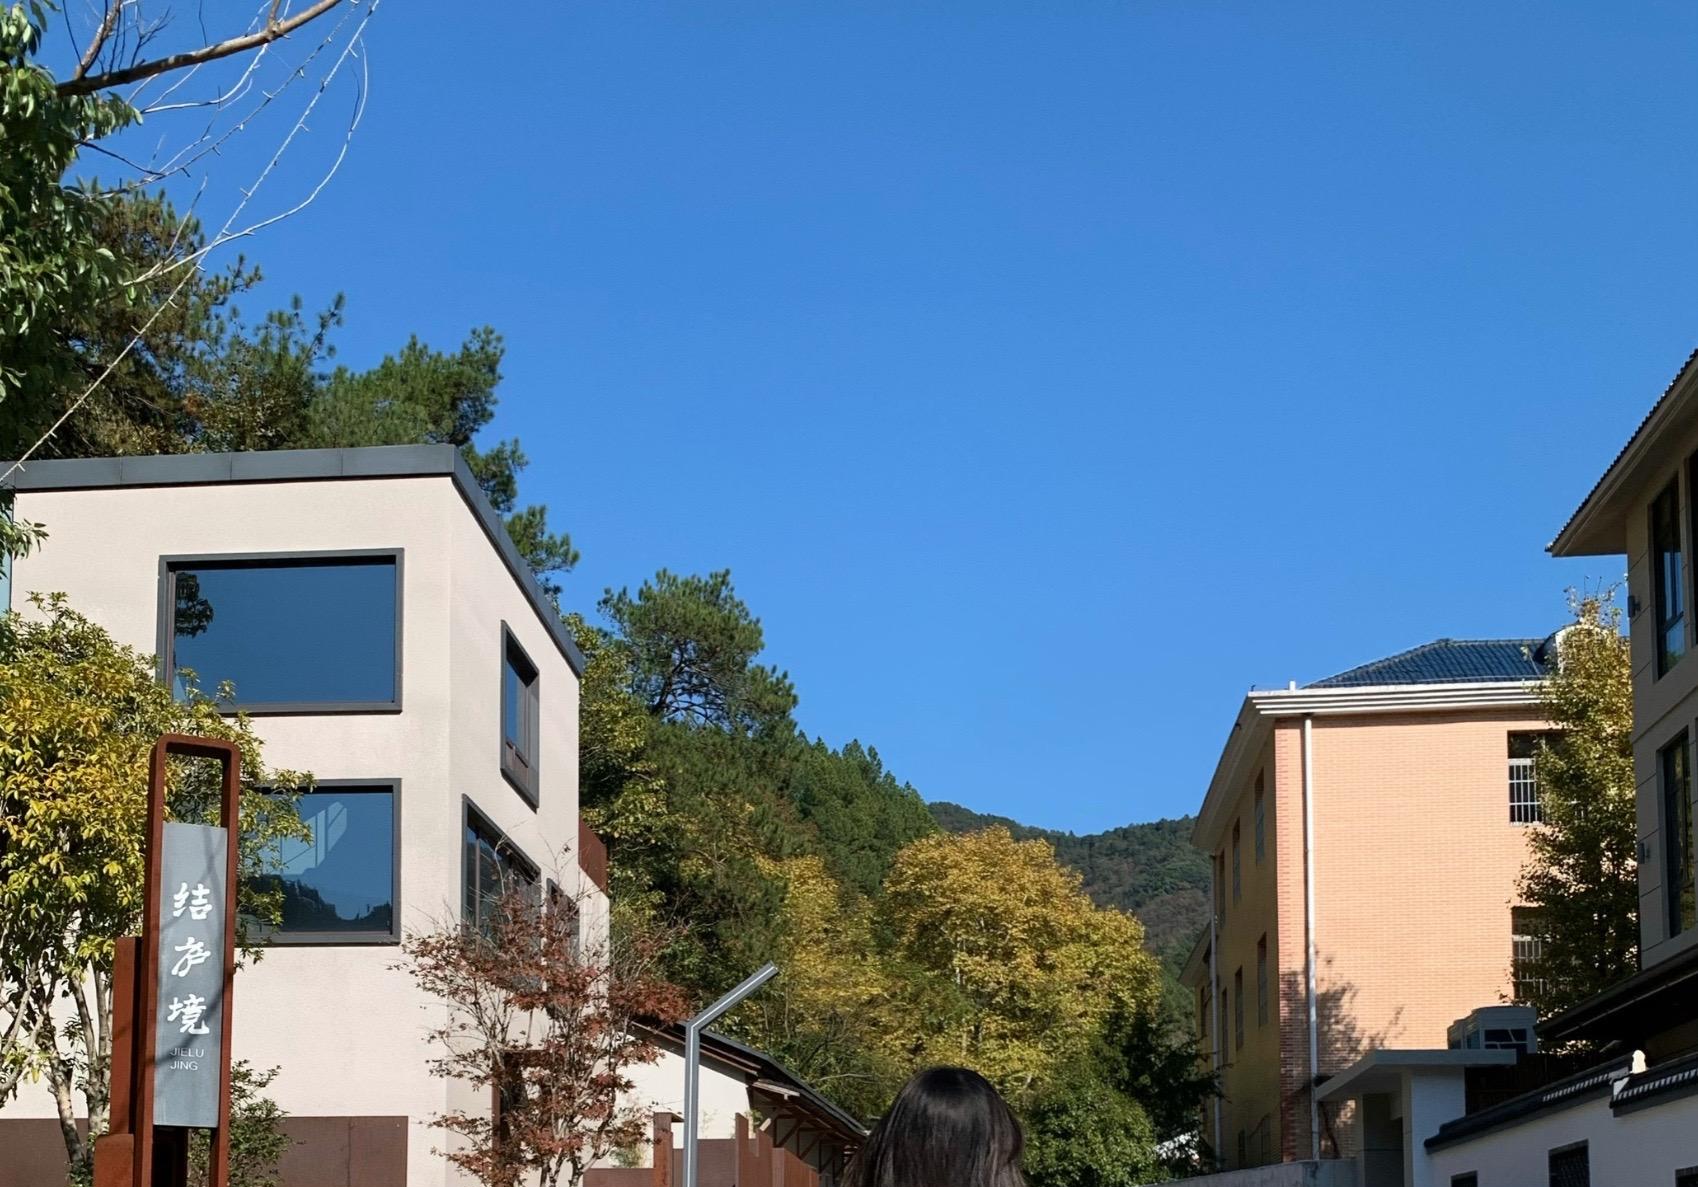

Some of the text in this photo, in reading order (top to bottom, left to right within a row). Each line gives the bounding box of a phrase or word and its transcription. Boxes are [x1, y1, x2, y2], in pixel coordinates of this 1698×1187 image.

[167, 881, 213, 1034] 结庐境
[169, 1047, 204, 1057] JIELU
[170, 1060, 198, 1070] JING
